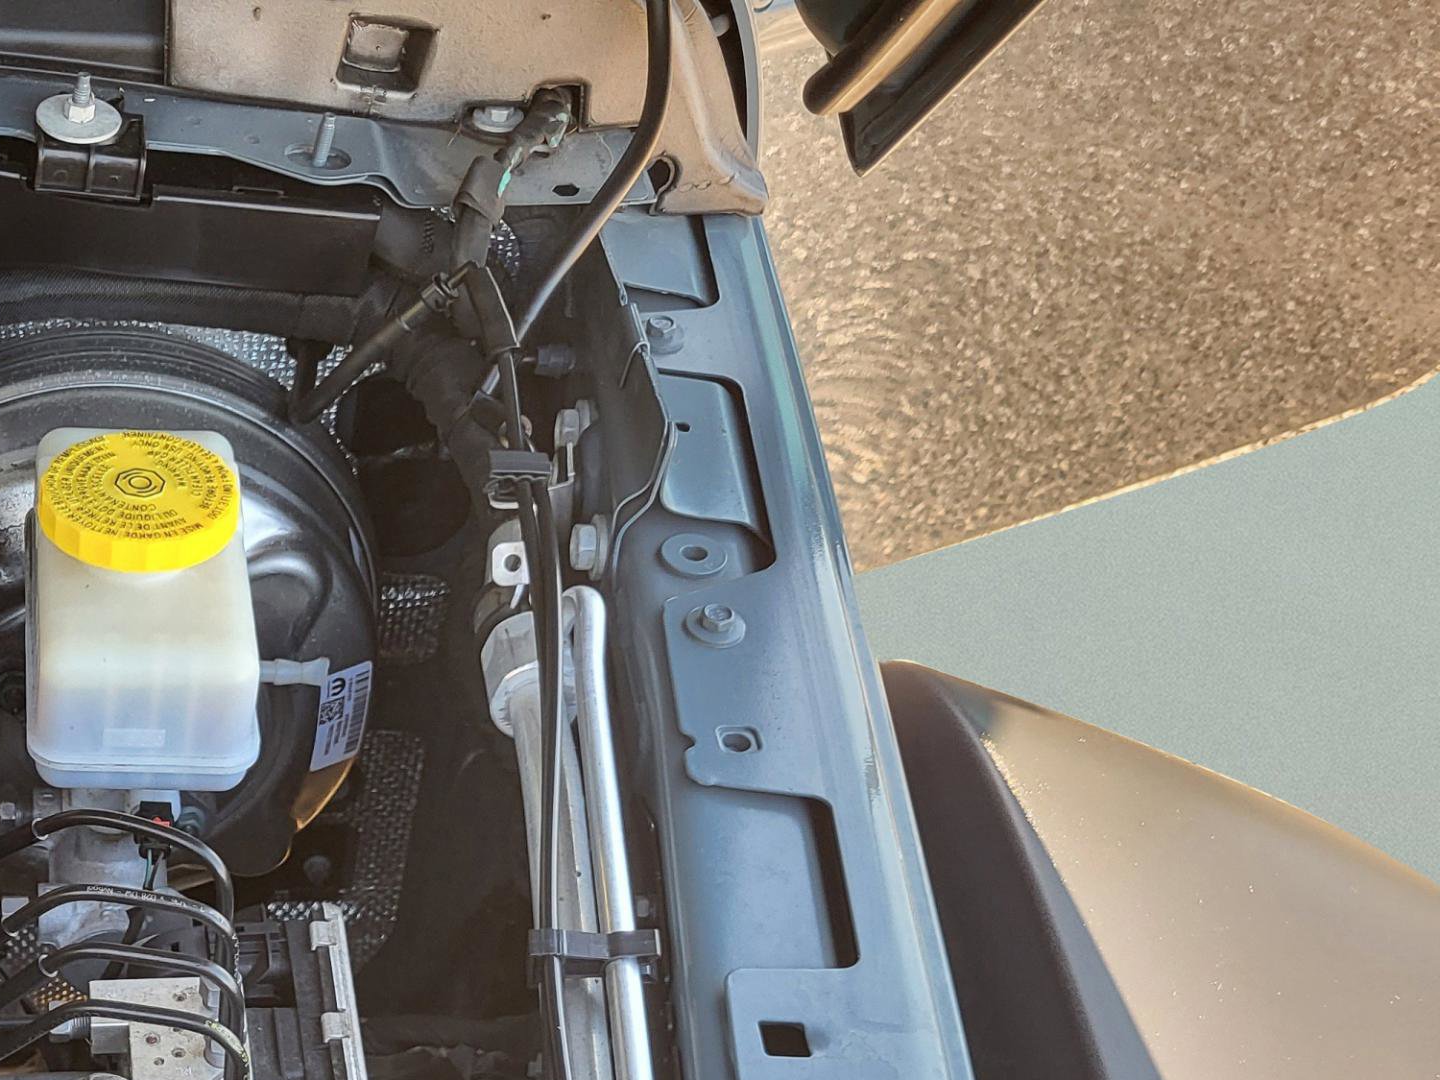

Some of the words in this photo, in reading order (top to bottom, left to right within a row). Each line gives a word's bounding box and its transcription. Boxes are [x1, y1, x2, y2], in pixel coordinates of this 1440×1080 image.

[119, 431, 184, 444] CONTAINER
[132, 440, 160, 448] ONLY
[145, 449, 170, 459] CAP
[160, 443, 184, 454] USE
[180, 439, 216, 459] SEALED
[188, 474, 202, 496] CLEAN
[195, 484, 218, 509] BEFORE
[114, 511, 163, 521] LIQUIDE
[154, 516, 188, 529] AVANT
[65, 512, 118, 536] NETTOYER
[177, 521, 204, 534] MISE
